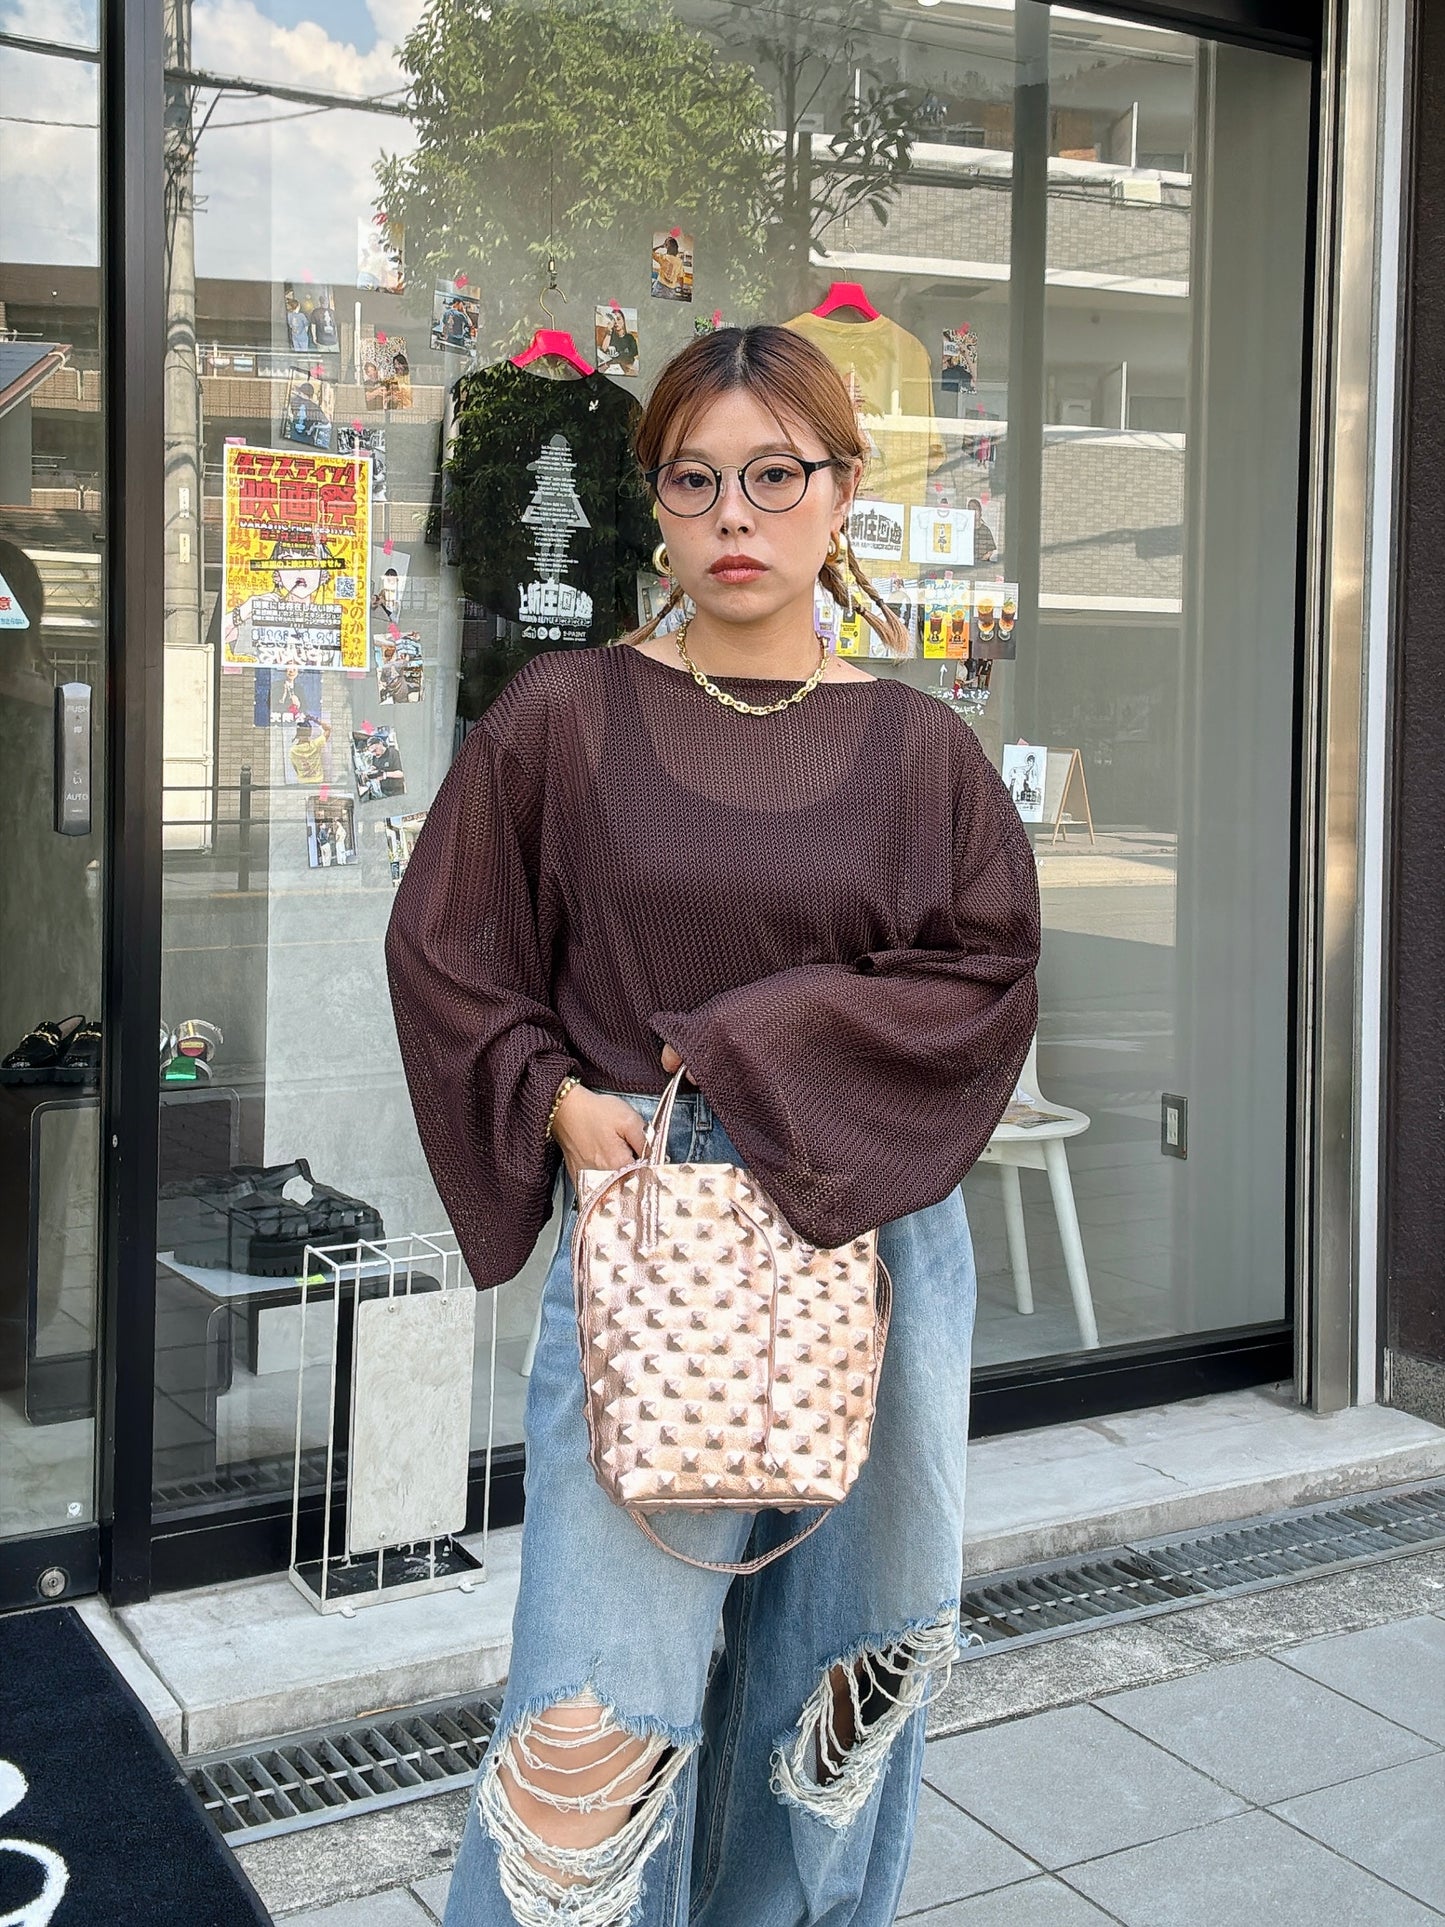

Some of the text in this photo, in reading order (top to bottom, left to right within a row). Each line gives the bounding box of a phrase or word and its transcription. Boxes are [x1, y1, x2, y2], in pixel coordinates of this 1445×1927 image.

[239, 477, 358, 526] 映画祭
[66, 704, 89, 713] PUSH
[66, 792, 89, 801] AUTO
